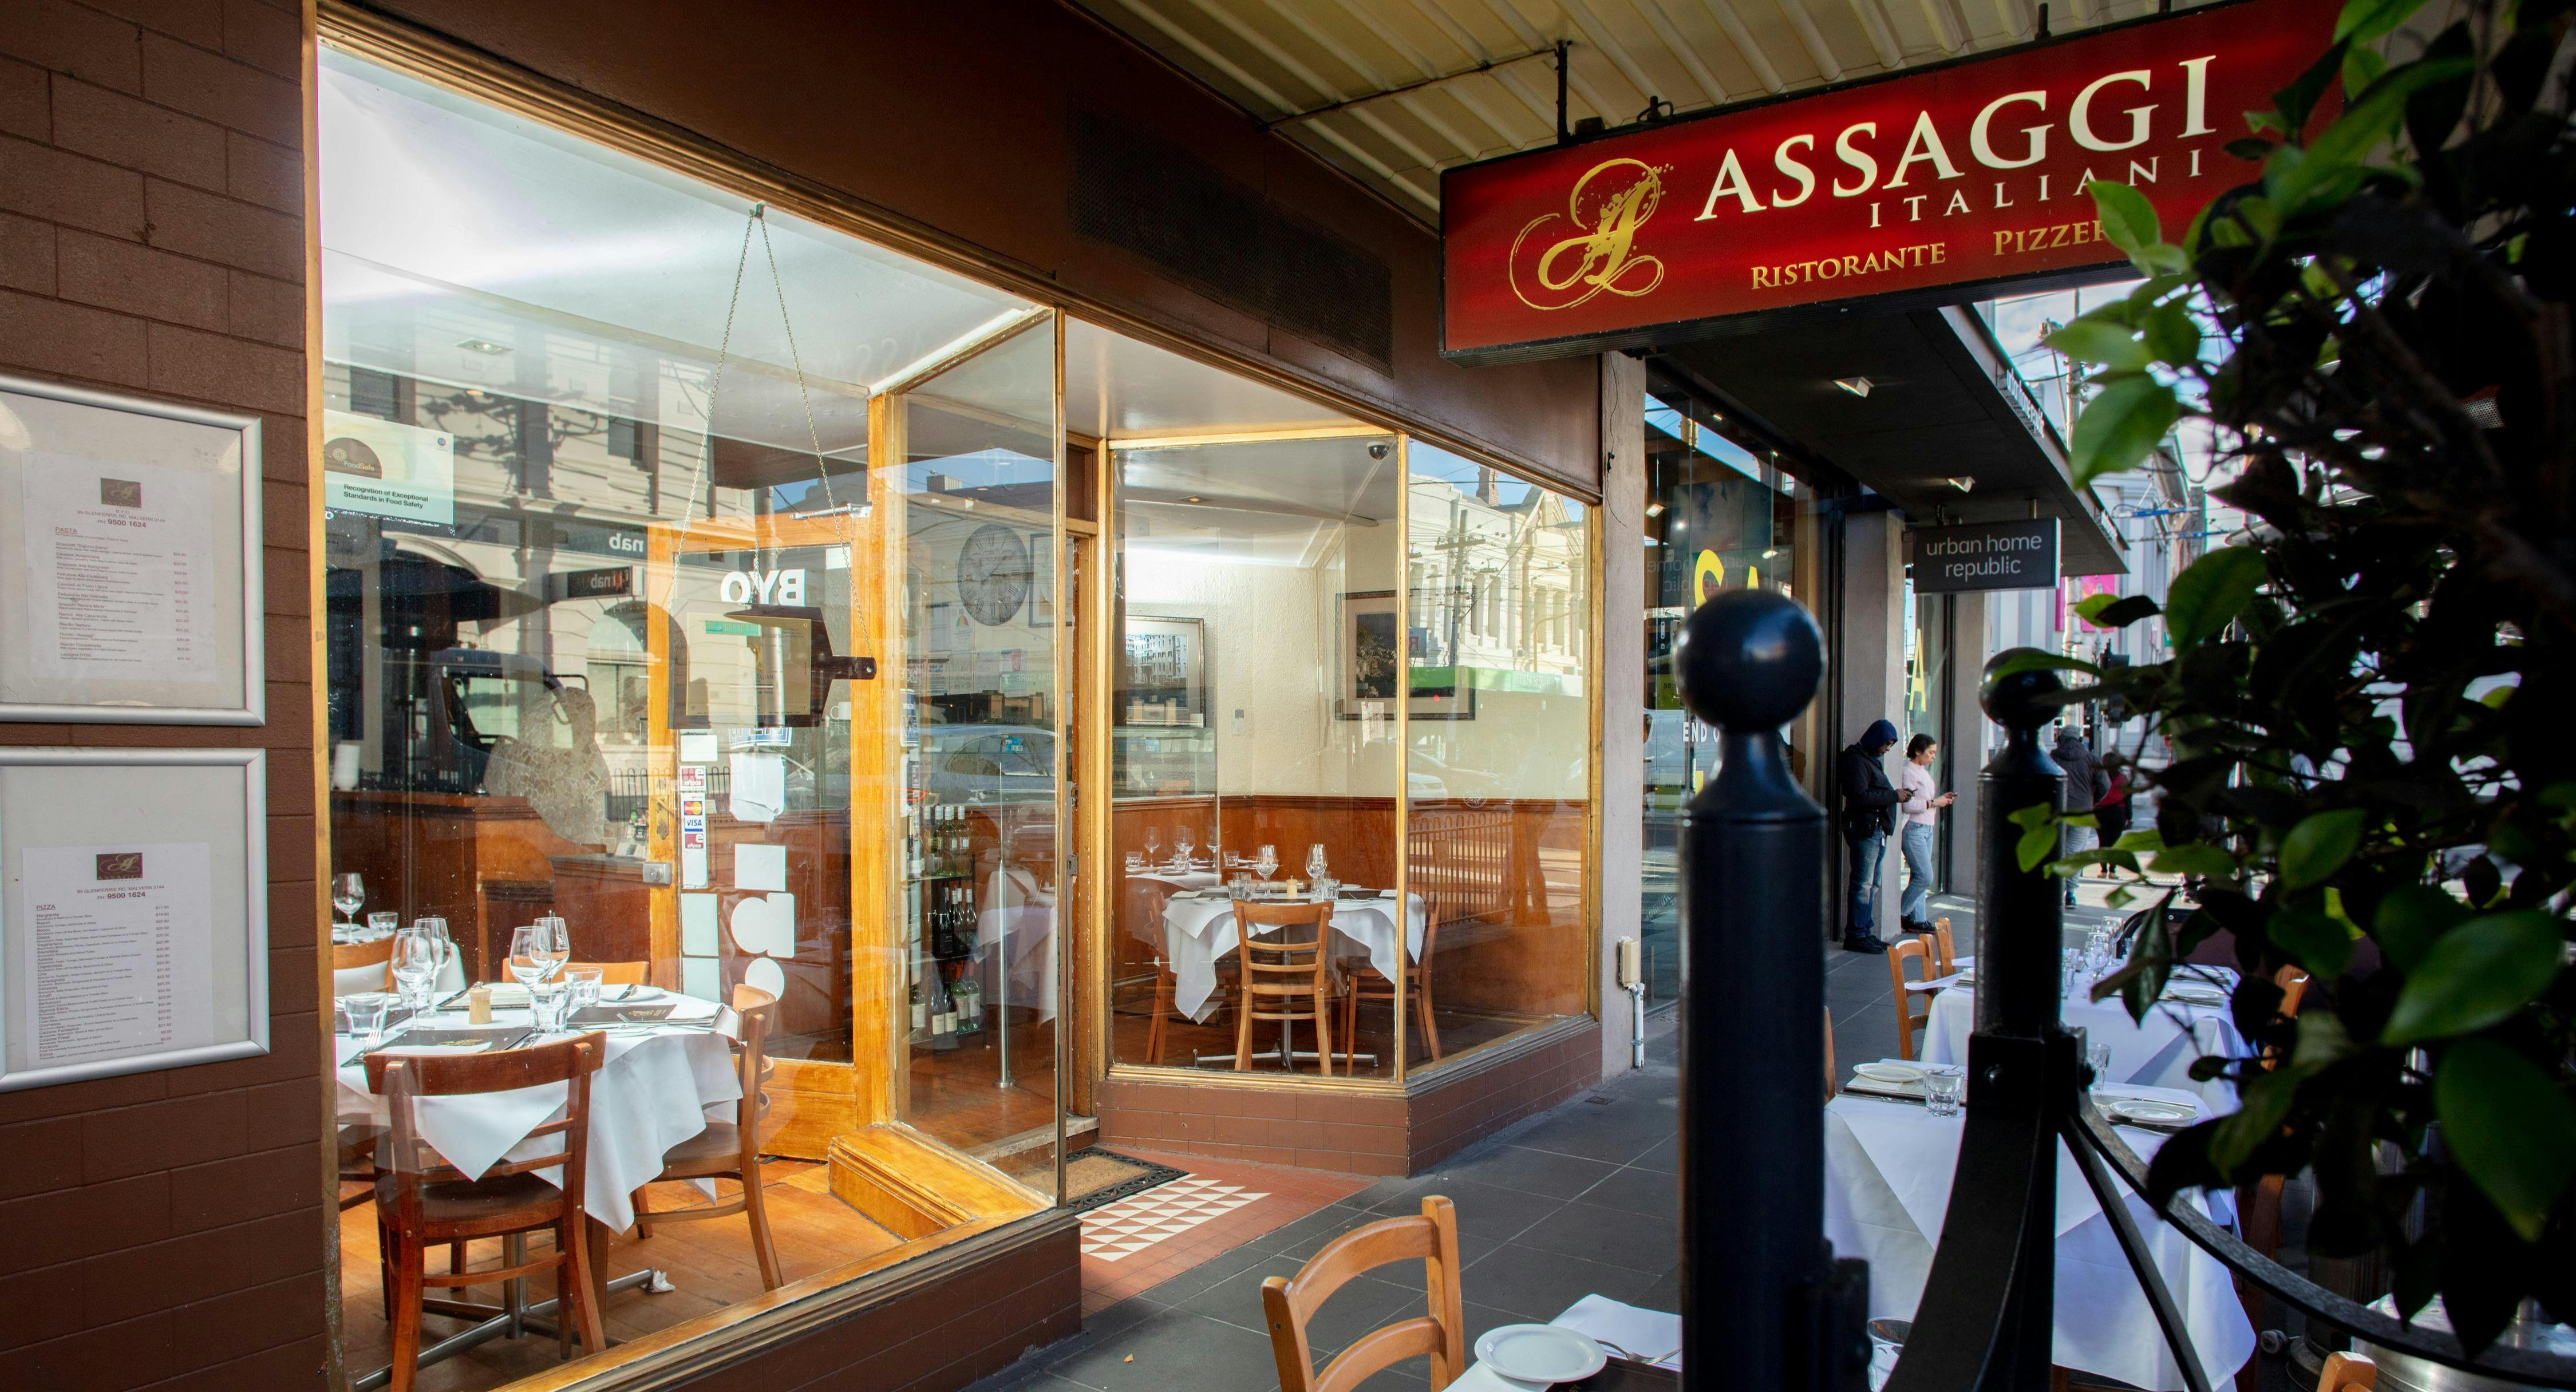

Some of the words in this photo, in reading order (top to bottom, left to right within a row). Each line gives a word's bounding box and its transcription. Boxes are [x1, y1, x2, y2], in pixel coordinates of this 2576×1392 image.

[1694, 55, 2217, 222] ASSAGGI
[1870, 149, 2203, 229] ITALIANI
[1750, 243, 1946, 290] RISTORANTE
[343, 460, 375, 472] FoodSafe
[343, 492, 377, 502] Standards
[404, 500, 424, 509] Safety
[344, 484, 382, 495] Recognition
[392, 491, 428, 502] Exceptional
[1926, 537, 1981, 556] urban
[1987, 535, 2042, 552] home
[1945, 555, 2021, 582] republic
[1683, 722, 1707, 742] END
